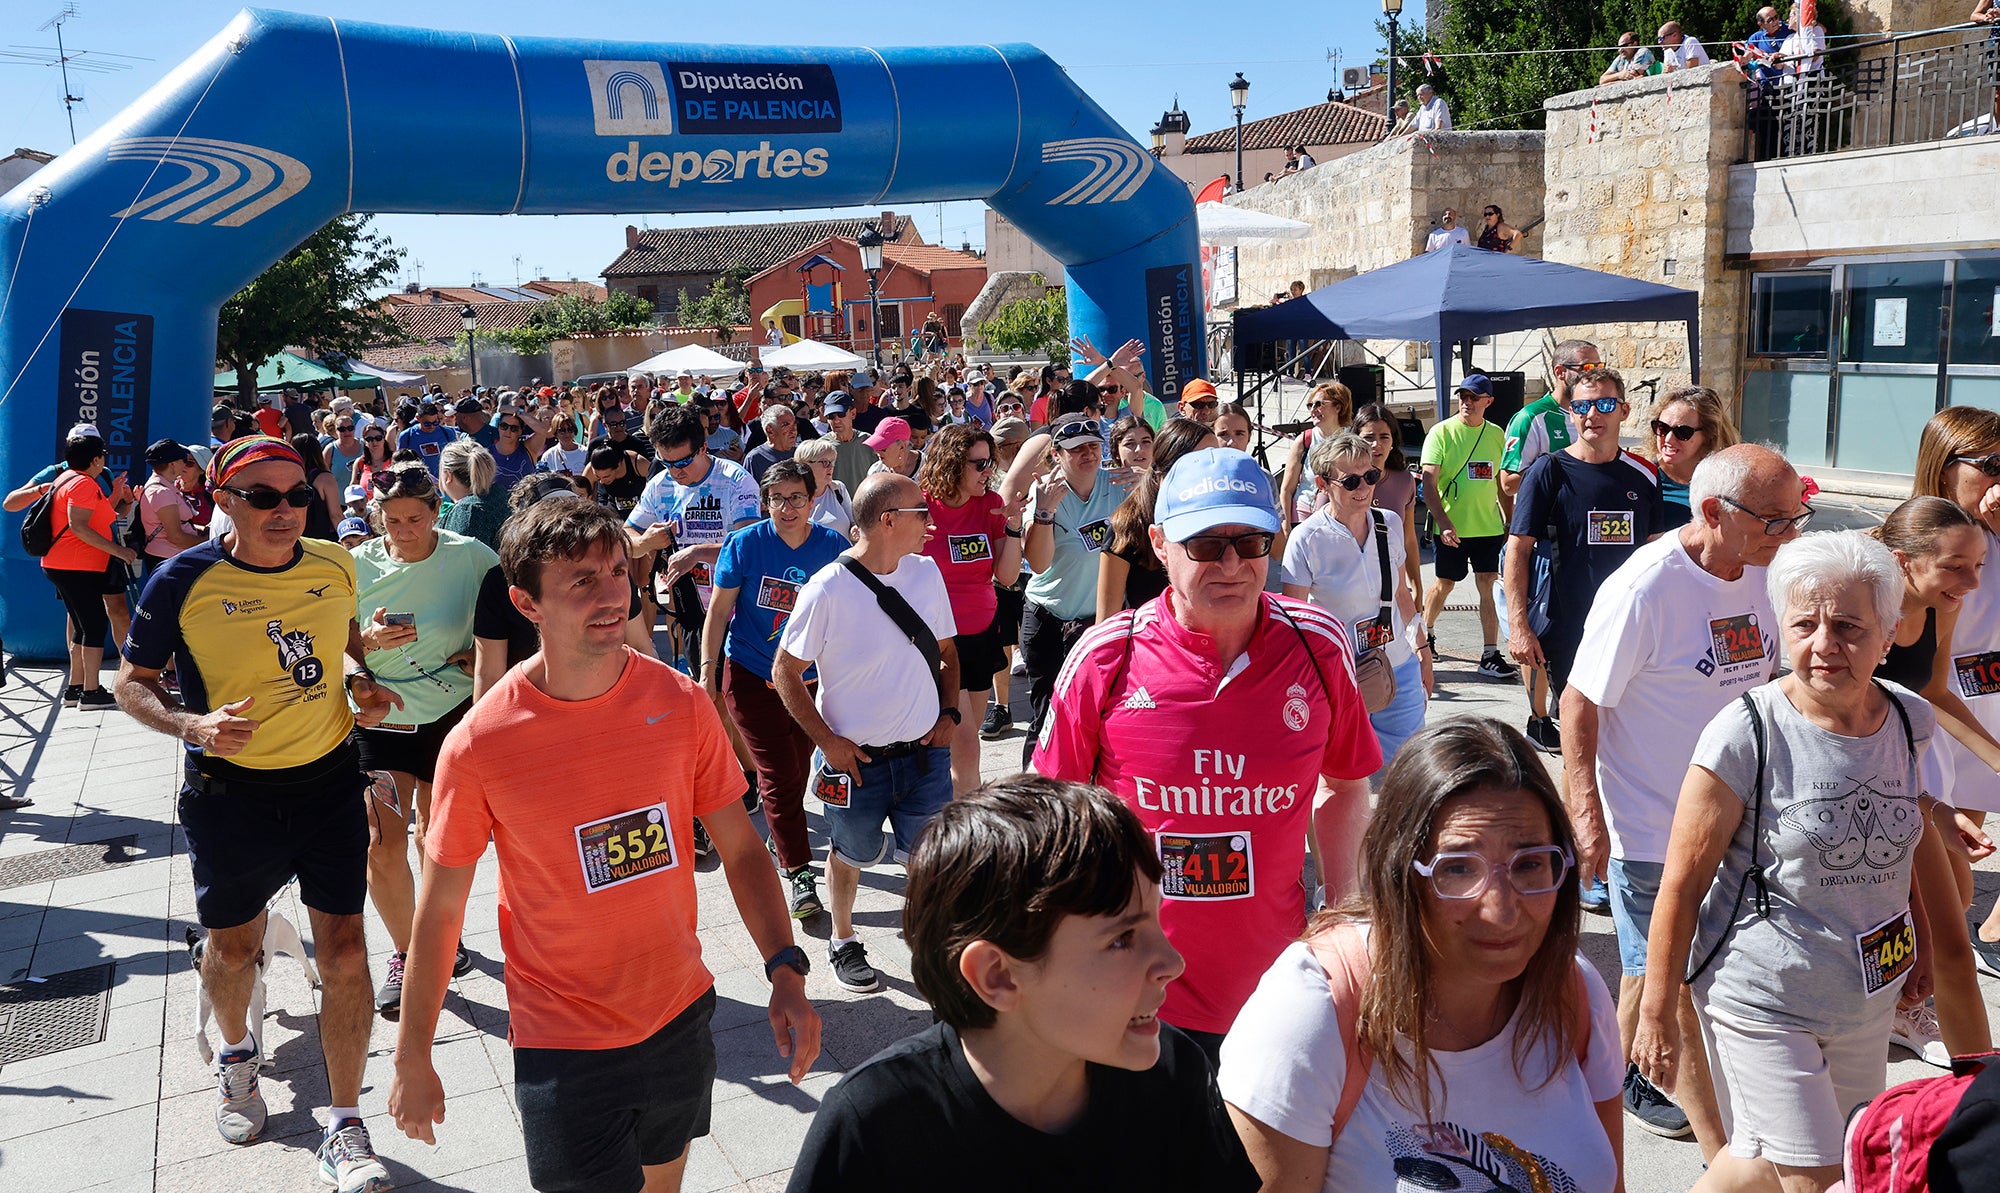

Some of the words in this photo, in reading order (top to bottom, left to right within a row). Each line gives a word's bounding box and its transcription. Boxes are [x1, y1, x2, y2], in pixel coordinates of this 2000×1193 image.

[678, 71, 804, 93] Diputación
[685, 100, 718, 120] DE
[724, 100, 836, 120] PALENCIA
[606, 141, 829, 188] deportes
[1176, 268, 1193, 361] PALENCIA
[1158, 295, 1178, 395] Diputación
[73, 350, 100, 427] tación
[108, 320, 138, 447] PALENCIA
[1178, 475, 1258, 502] adidas
[685, 510, 722, 520] CARRERA
[1601, 520, 1630, 535] 523
[960, 541, 986, 555] 507
[1725, 625, 1760, 651] 243
[298, 663, 317, 680] 13
[1124, 700, 1157, 709] adidas
[1193, 749, 1246, 780] Fly
[817, 777, 847, 799] 245
[1133, 776, 1299, 816] Emirates
[1812, 781, 1839, 790] KEEP
[1882, 780, 1902, 788] YOUR
[607, 823, 668, 866] 552
[609, 852, 670, 879] VILLALOBÓN
[1183, 851, 1248, 881] 412
[1184, 880, 1248, 895] VILLALOBÓN
[1820, 874, 1866, 887] DREAMS
[1868, 871, 1899, 884] ALIVE
[1880, 926, 1914, 968] 463
